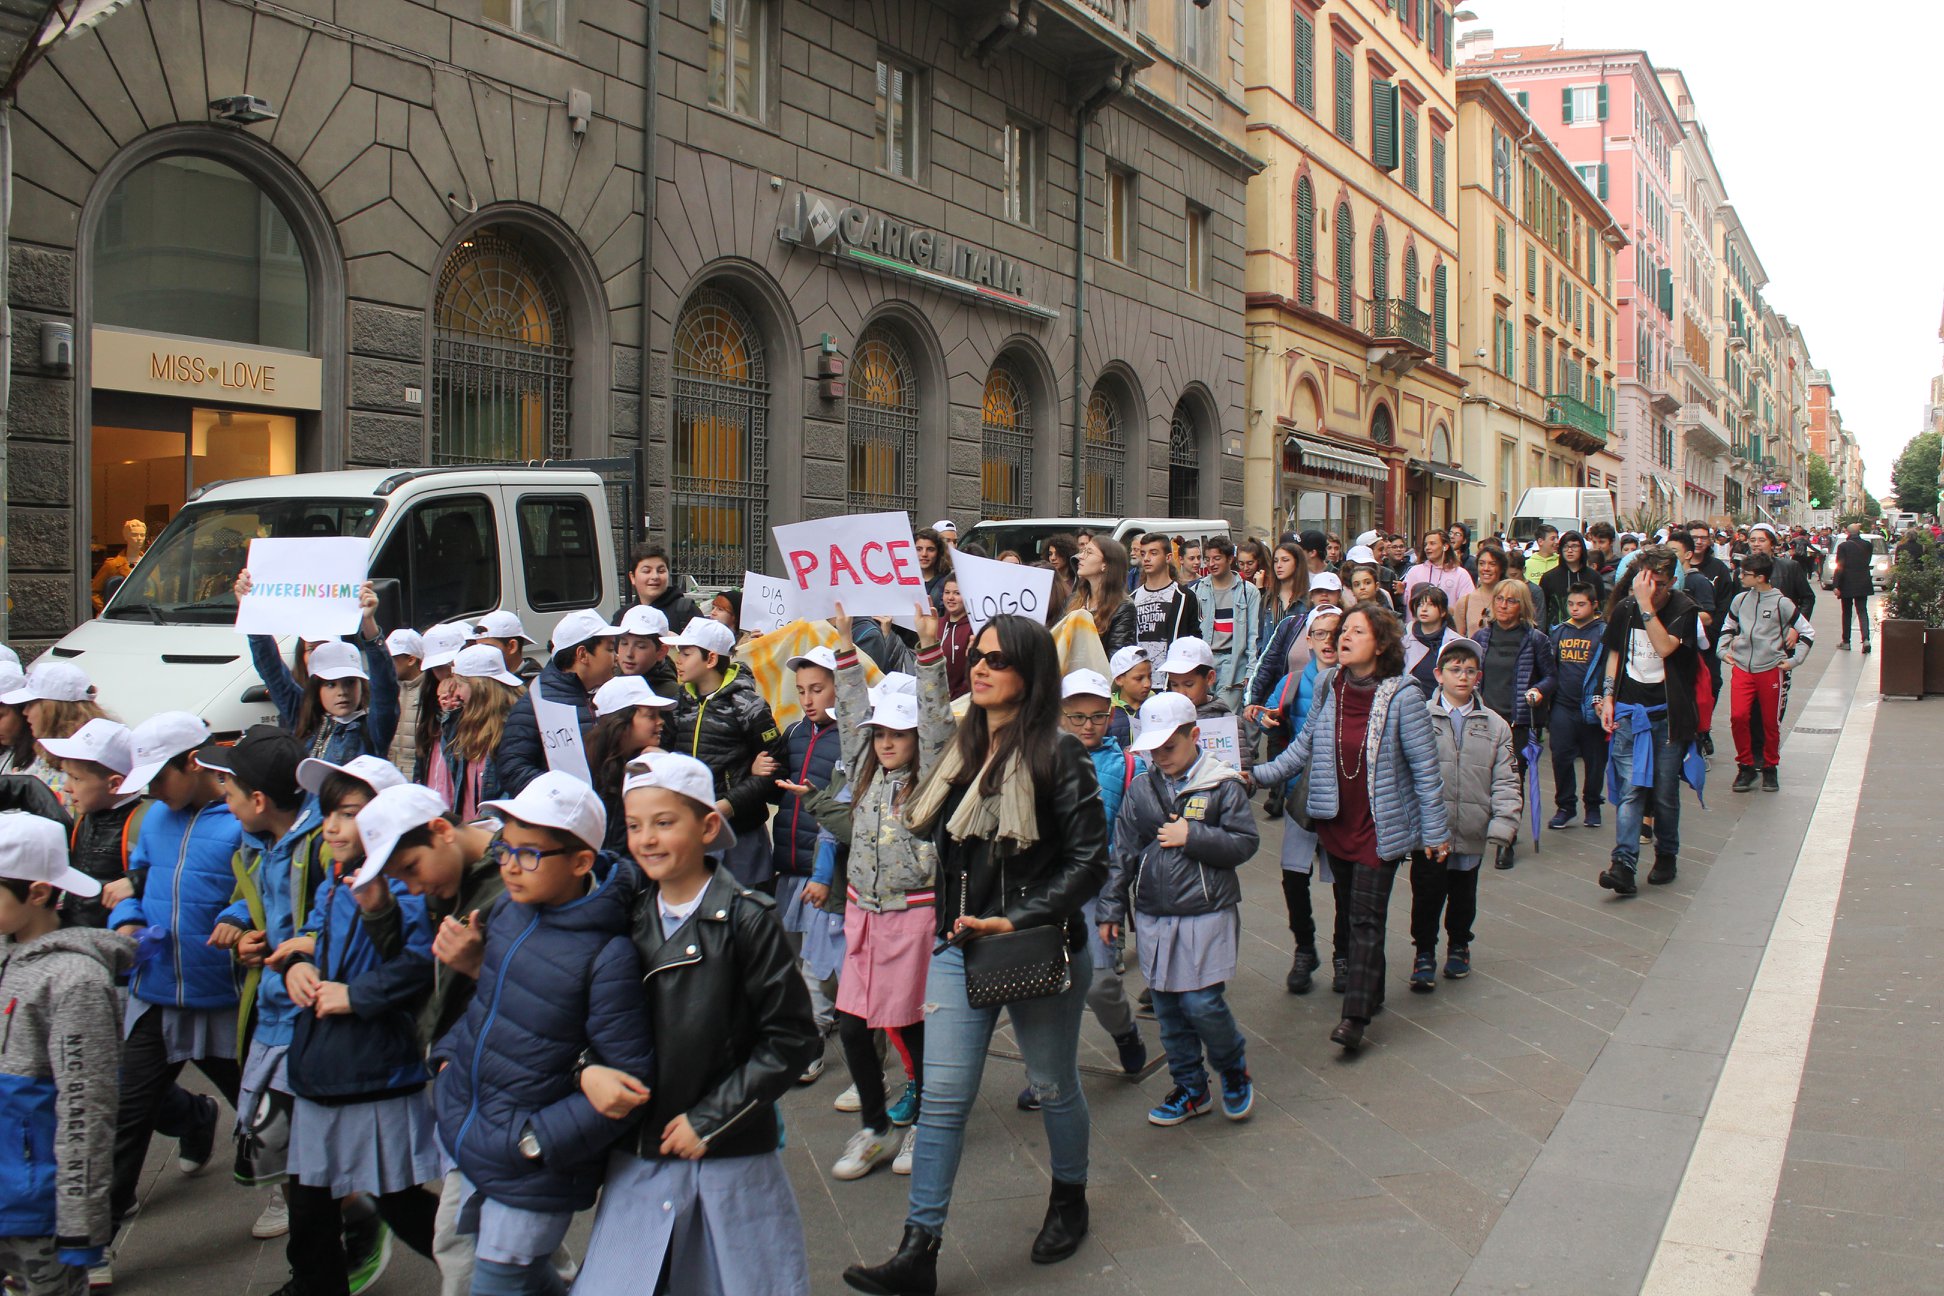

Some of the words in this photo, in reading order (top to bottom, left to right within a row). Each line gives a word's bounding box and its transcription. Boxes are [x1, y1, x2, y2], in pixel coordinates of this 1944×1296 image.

[837, 206, 948, 273] CARIGE
[952, 243, 1025, 297] ITALIA
[151, 352, 205, 383] MISS
[220, 360, 277, 392] LOVE
[789, 541, 921, 590] PACE
[762, 585, 783, 601] DIA
[769, 602, 786, 615] LO
[66, 1034, 84, 1073] NYC
[68, 1159, 84, 1197] NYC
